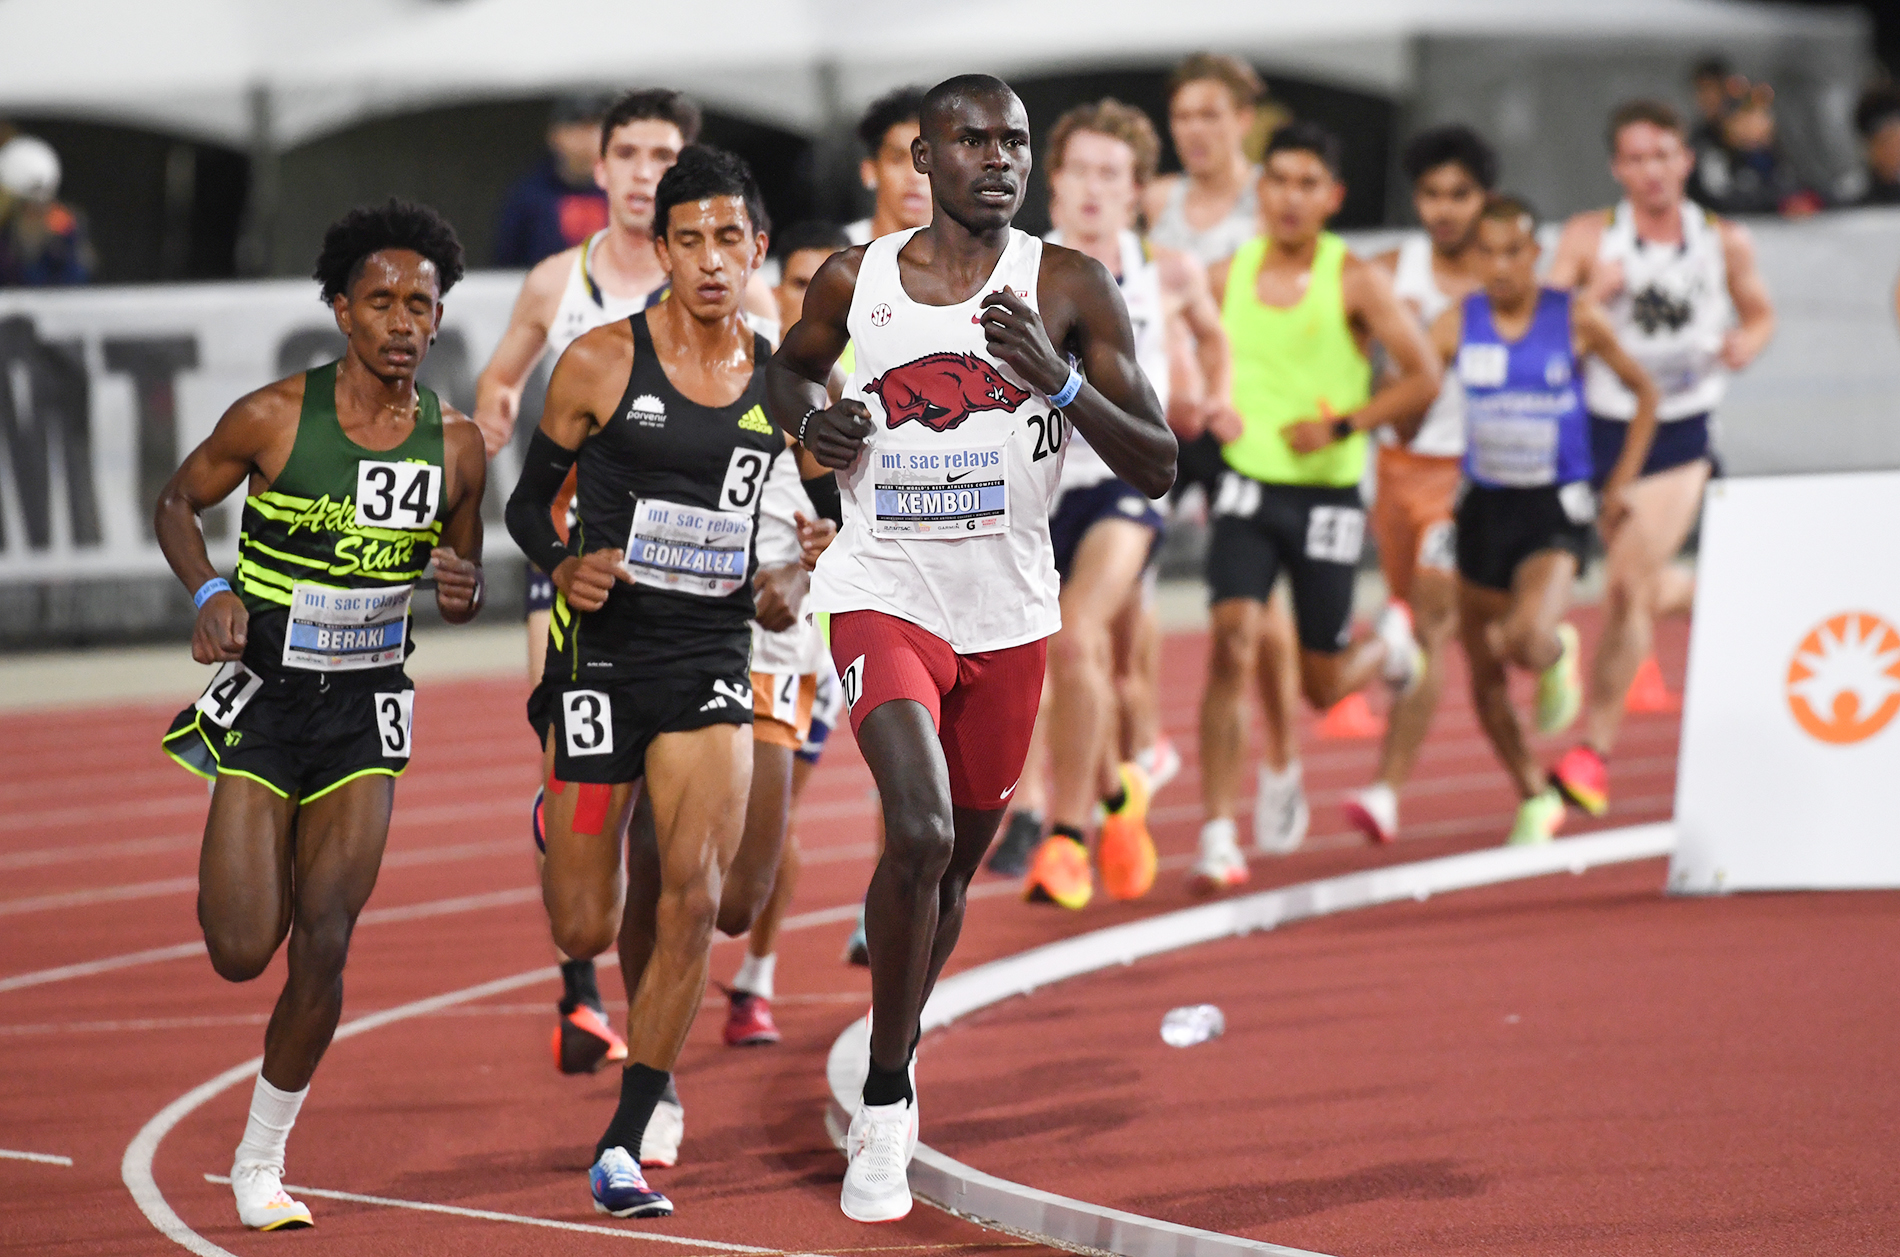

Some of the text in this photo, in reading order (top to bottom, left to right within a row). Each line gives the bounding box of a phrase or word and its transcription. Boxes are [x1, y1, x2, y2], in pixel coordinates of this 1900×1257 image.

[626, 410, 667, 422] porvenir
[737, 419, 774, 435] adidas
[1027, 408, 1062, 463] 20
[882, 453, 906, 469] mt.
[910, 455, 939, 469] sac
[945, 451, 999, 468] relays
[728, 454, 762, 507] 3
[363, 466, 431, 524] 34
[897, 490, 980, 514] KEMBOI
[647, 509, 747, 534] mt. sac relays
[966, 520, 976, 530] G
[642, 543, 735, 573] GONZALEZ
[305, 594, 329, 609] mt.
[334, 598, 360, 610] sac
[317, 627, 385, 650] BERAKI
[211, 671, 252, 720] 4
[571, 694, 605, 749] 3
